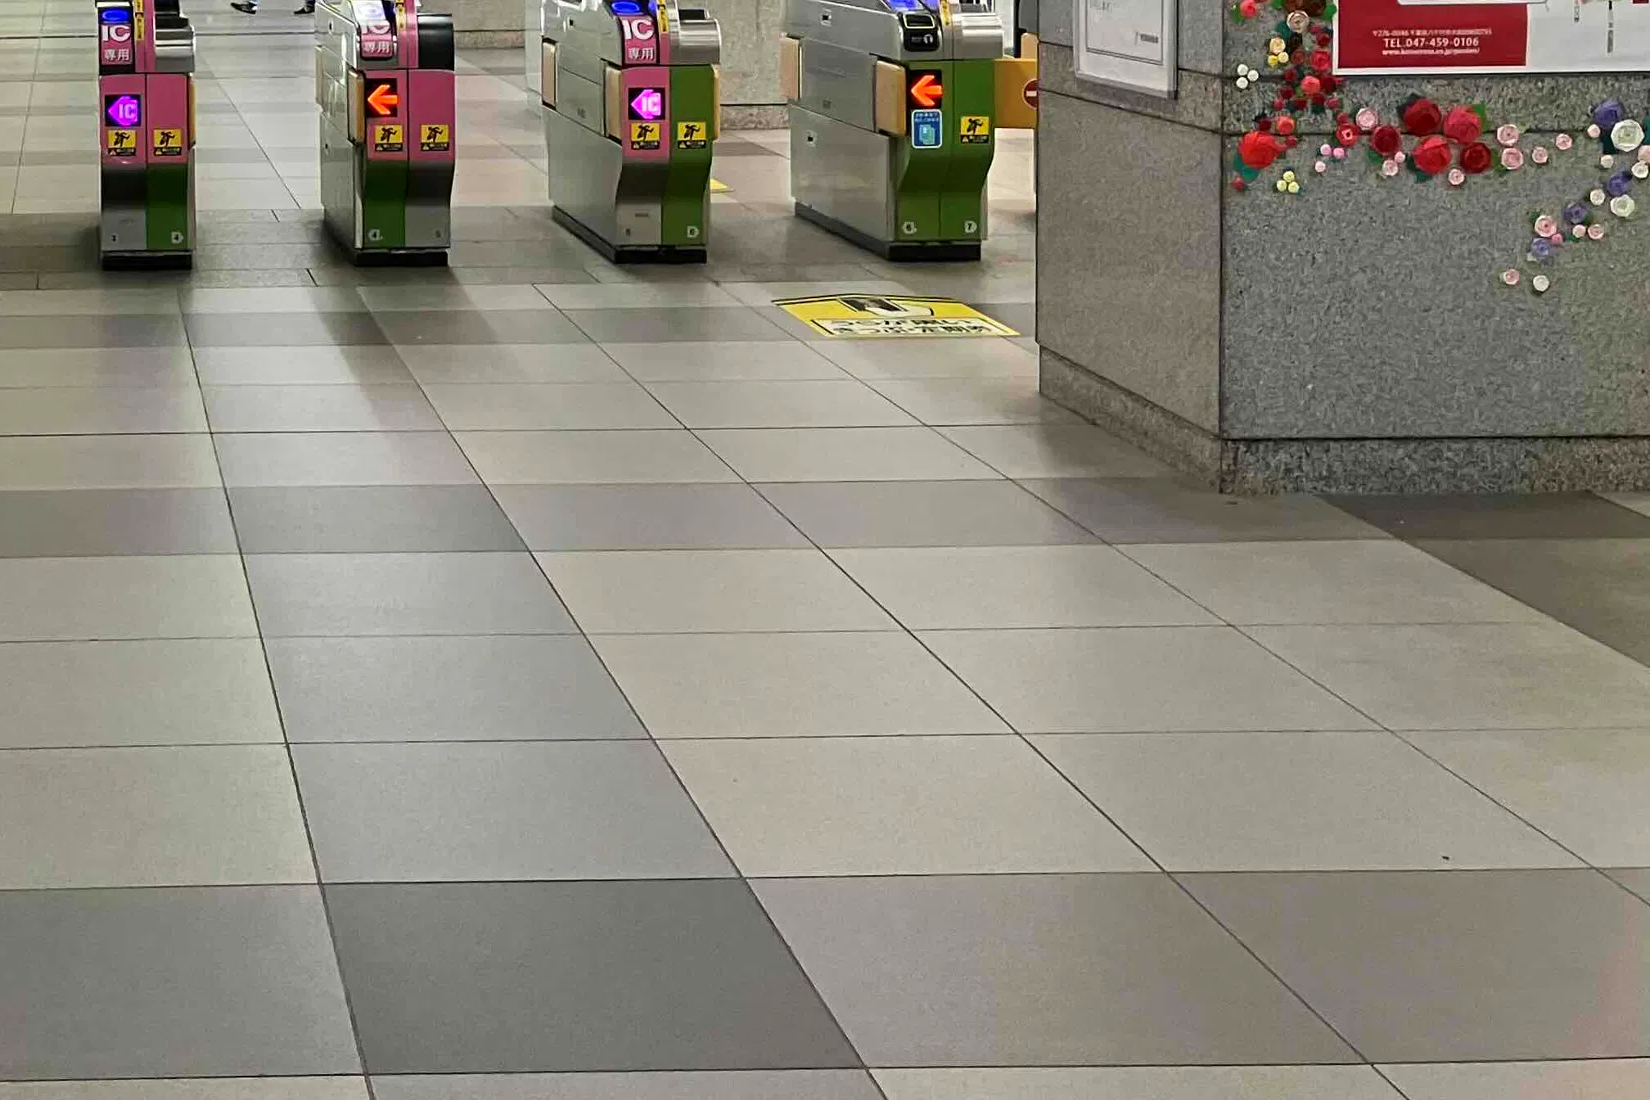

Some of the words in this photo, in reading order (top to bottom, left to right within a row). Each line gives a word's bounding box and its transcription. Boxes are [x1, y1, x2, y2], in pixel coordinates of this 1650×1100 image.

[101, 24, 131, 43] IC
[621, 18, 655, 41] IC
[104, 48, 130, 62] 専用
[628, 47, 654, 60] 専用
[118, 103, 137, 119] IC
[641, 101, 659, 113] IC
